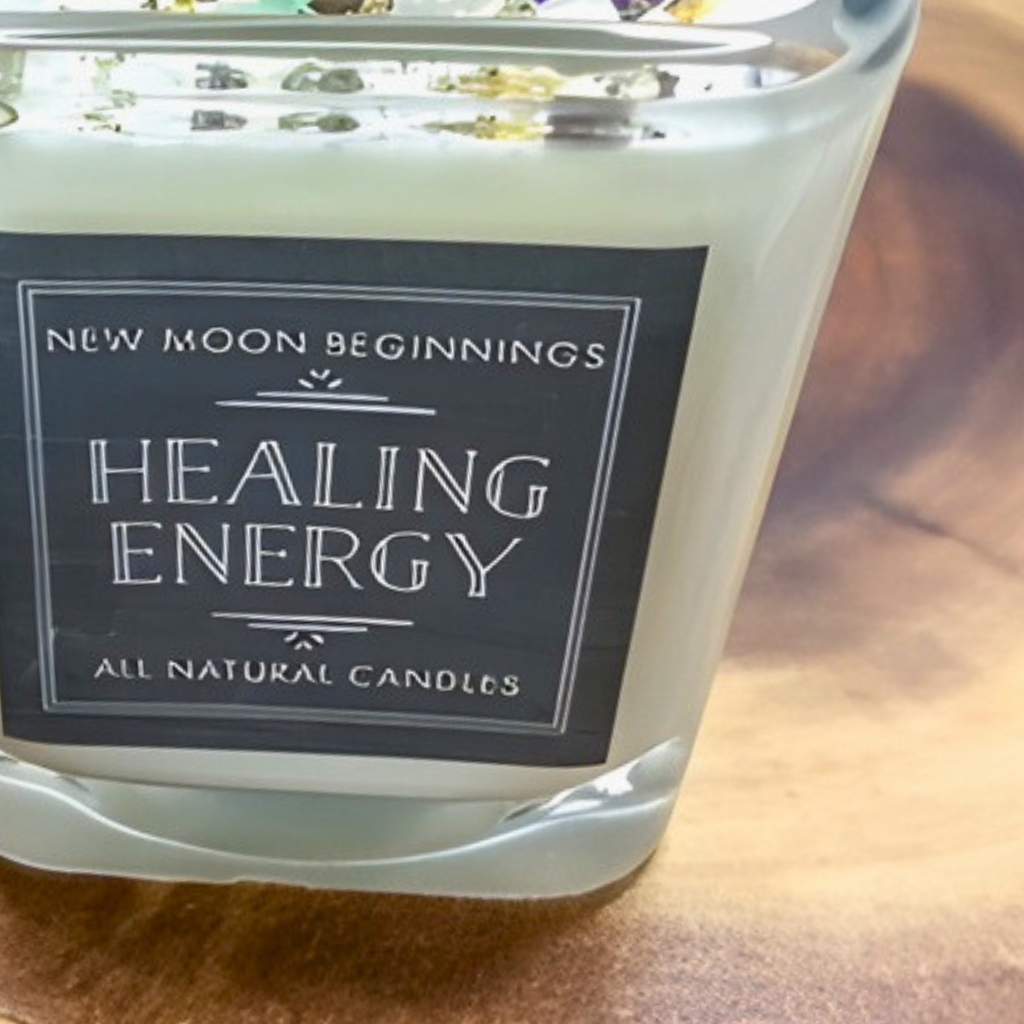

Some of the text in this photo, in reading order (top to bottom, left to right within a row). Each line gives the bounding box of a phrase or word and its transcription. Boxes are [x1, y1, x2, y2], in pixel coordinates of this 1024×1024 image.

[44, 325, 609, 372] NEW MOON BEGINNINGS
[88, 437, 552, 520] HEALING
[110, 520, 524, 598] ENERGY
[94, 656, 153, 681] ALL
[166, 658, 333, 686] NATURAL
